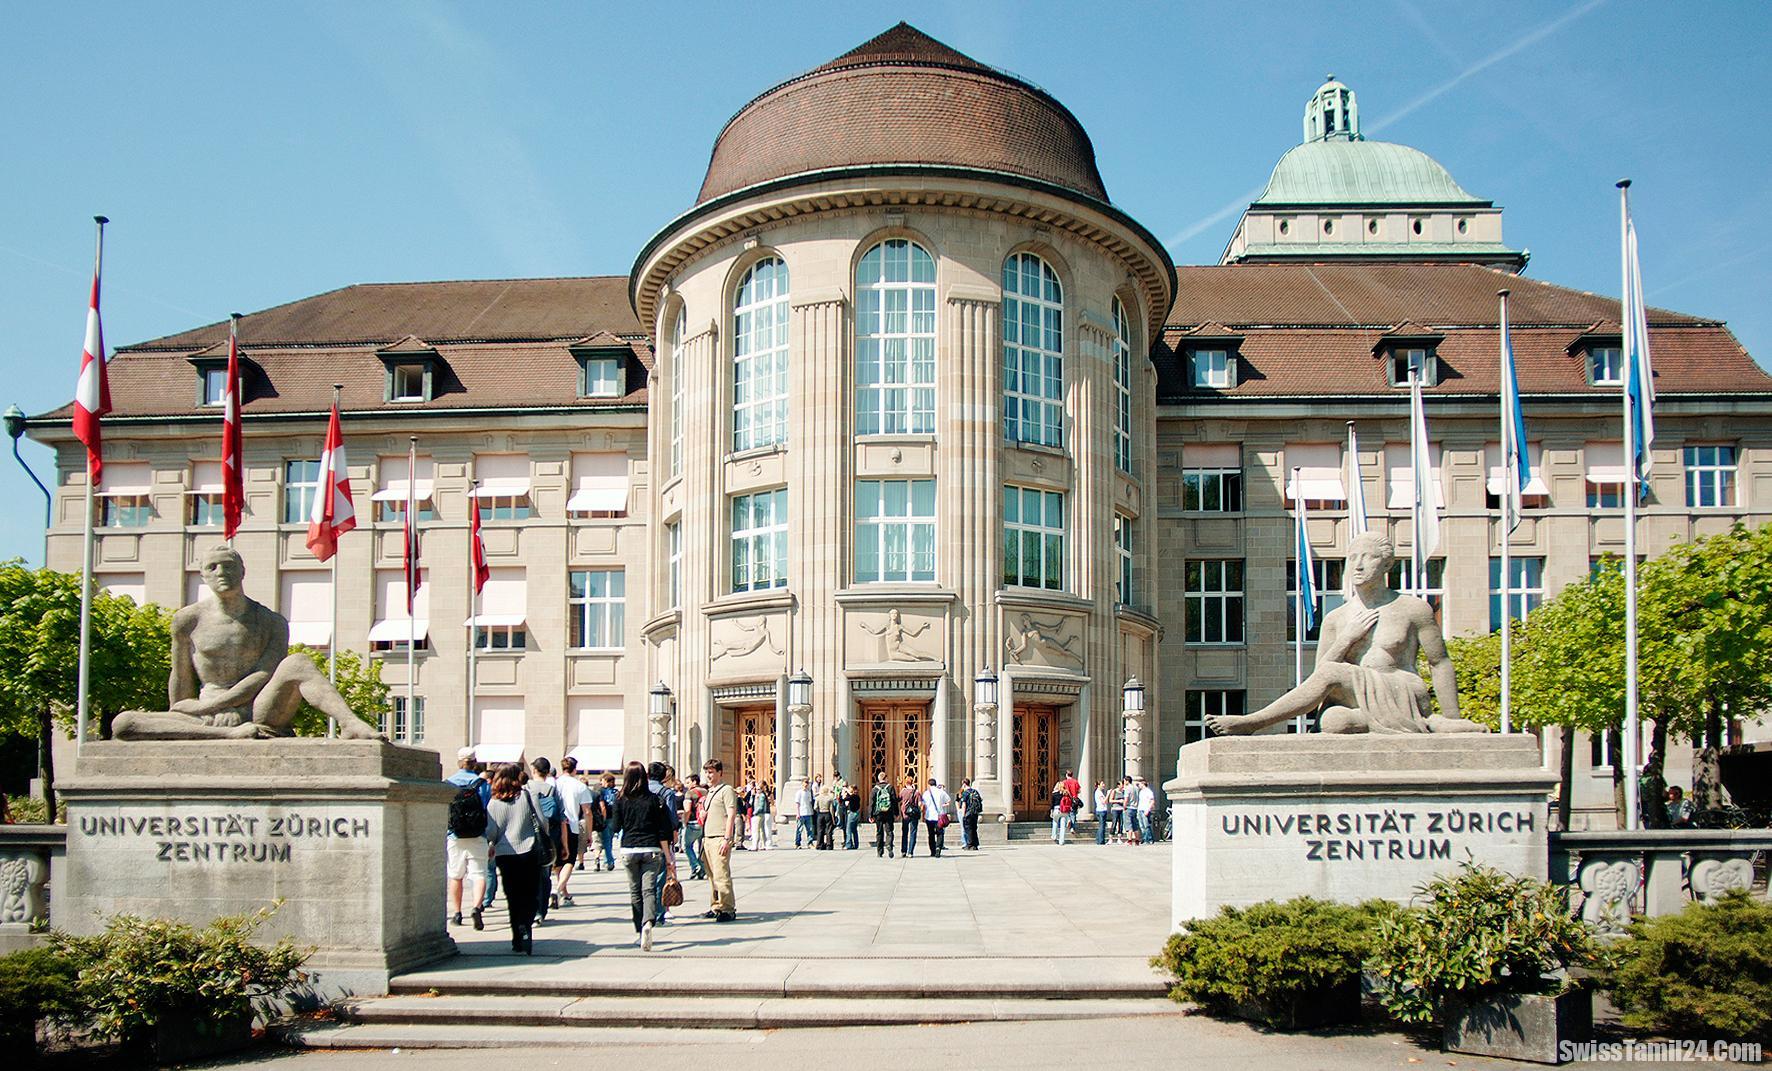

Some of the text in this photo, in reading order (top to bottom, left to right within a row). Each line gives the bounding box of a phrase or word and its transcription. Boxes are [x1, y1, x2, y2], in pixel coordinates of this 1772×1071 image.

[80, 813, 370, 838] UNIVERSITÄT ZÜRICH
[1222, 809, 1535, 836] UNIVERSITÄT ZÜRICH
[156, 841, 292, 862] ZENTRUM
[1306, 839, 1452, 861] ZENTRUM
